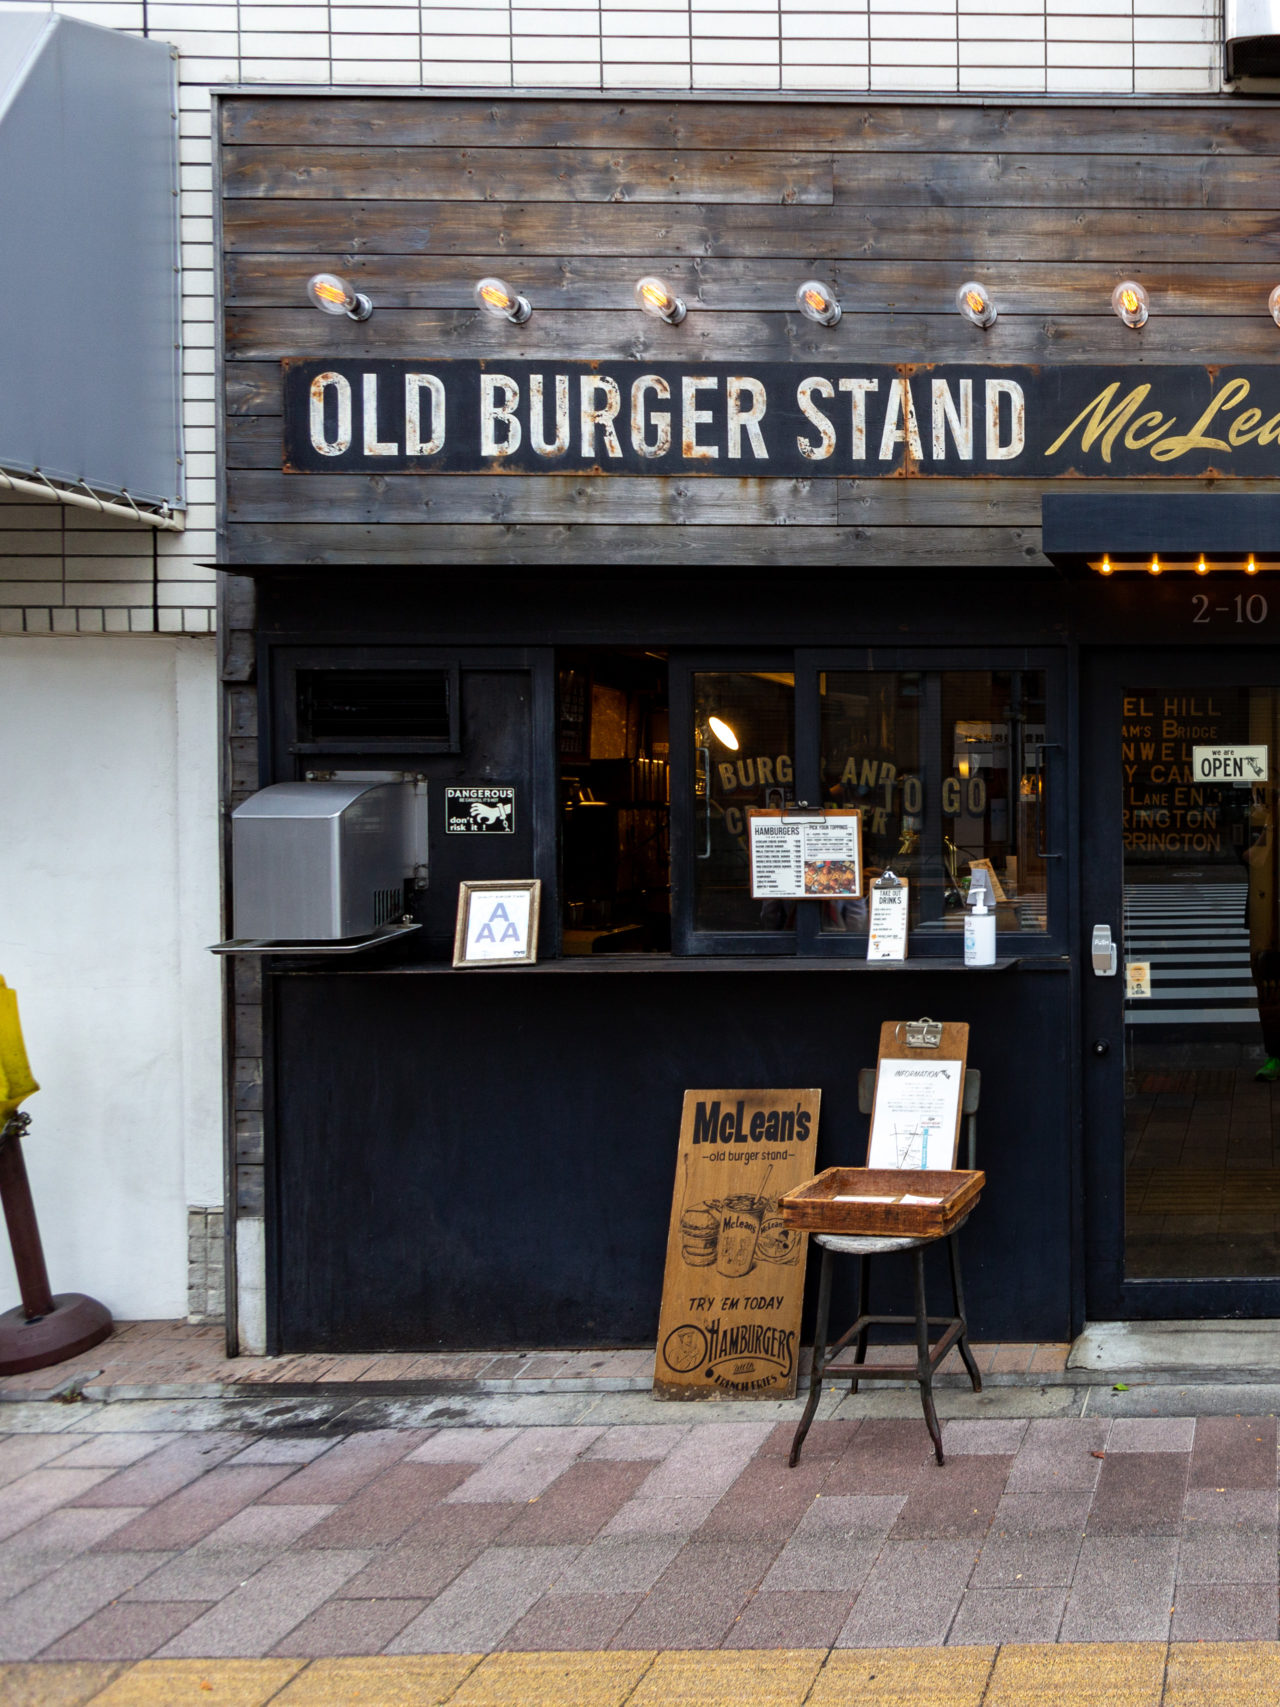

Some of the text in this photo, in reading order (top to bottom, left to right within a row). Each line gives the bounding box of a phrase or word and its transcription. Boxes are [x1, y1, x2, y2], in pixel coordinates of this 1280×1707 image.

[308, 371, 1026, 461] OLD BURGER STAND
[1191, 594, 1268, 624] 2-10
[1163, 697, 1222, 717] HILL
[841, 756, 897, 790] AND
[1201, 757, 1244, 777] OPEN
[447, 789, 513, 798] DANGEROUS
[879, 776, 988, 816] TO GO
[449, 816, 474, 824] don't
[754, 826, 800, 836] HAMBURGERS
[879, 896, 902, 904] DRINKS
[894, 1070, 939, 1078] INFORMATION
[692, 1100, 812, 1145] McLean's
[728, 1150, 759, 1165] burger
[688, 1297, 713, 1311] TRY
[743, 1295, 785, 1310] TODAY
[705, 1318, 795, 1376] HAMBURGERS
[714, 1374, 777, 1392] FRENCH FRIES
